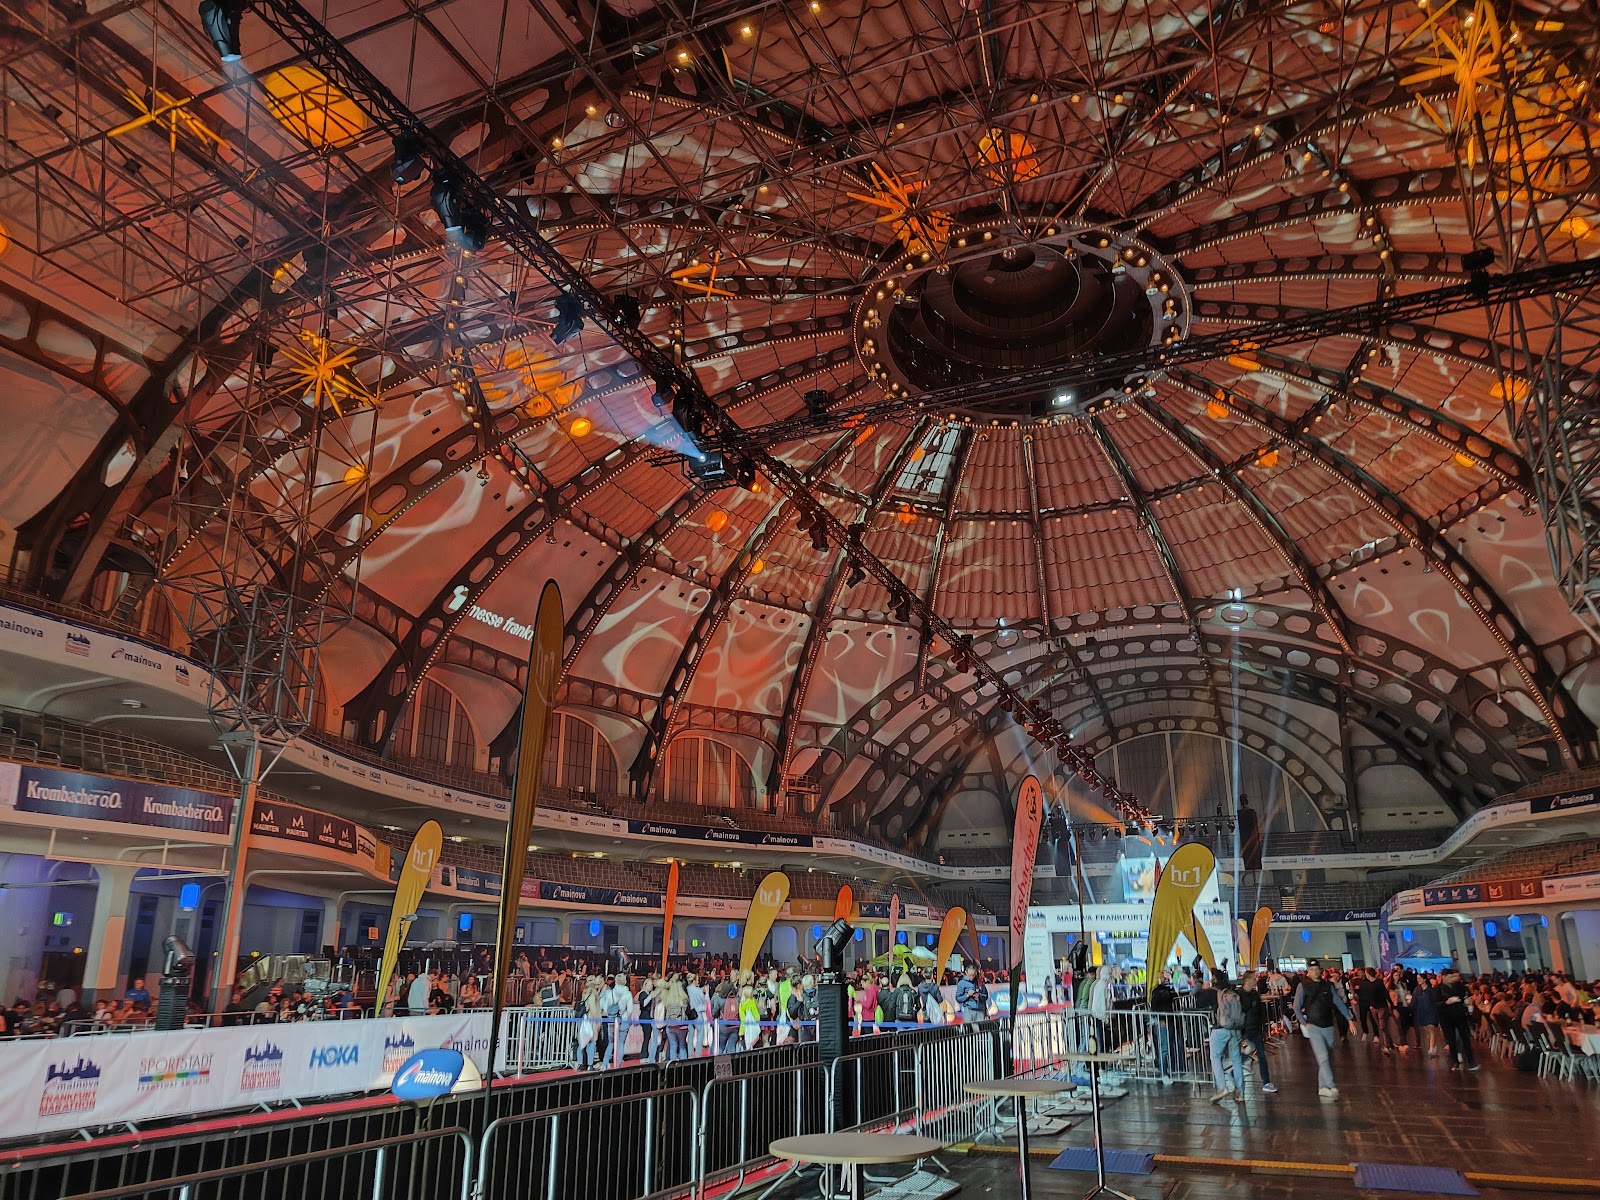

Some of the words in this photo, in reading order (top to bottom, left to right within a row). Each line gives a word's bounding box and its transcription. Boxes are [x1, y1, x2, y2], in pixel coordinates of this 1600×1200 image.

[466, 604, 504, 628] messe
[124, 653, 162, 670] mainova
[26, 780, 100, 807] Krombacher
[1560, 792, 1595, 806] mainova
[143, 796, 205, 819] Krombacher
[253, 823, 279, 833] MAURTEN
[286, 828, 309, 838] MAURTEN
[650, 825, 677, 835] mainova
[318, 834, 336, 844] MAURTEN
[712, 831, 740, 841] mainova
[770, 835, 798, 844] mainova
[412, 843, 433, 868] hr1
[1170, 865, 1201, 883] hr1
[1013, 827, 1035, 936] Rosbacher
[560, 889, 586, 900] mainova
[620, 894, 648, 904] mainova
[1095, 913, 1144, 921] FRANKFURT
[1279, 913, 1311, 921] mainova
[452, 1036, 500, 1051] mainoa
[139, 1052, 215, 1074] SPORTSTADT
[308, 1044, 360, 1070] HOKA
[413, 1067, 453, 1087] mainova
[56, 1079, 99, 1091] mainova
[41, 1090, 96, 1103] FRANKFURT
[38, 1100, 96, 1116] MARATHON
